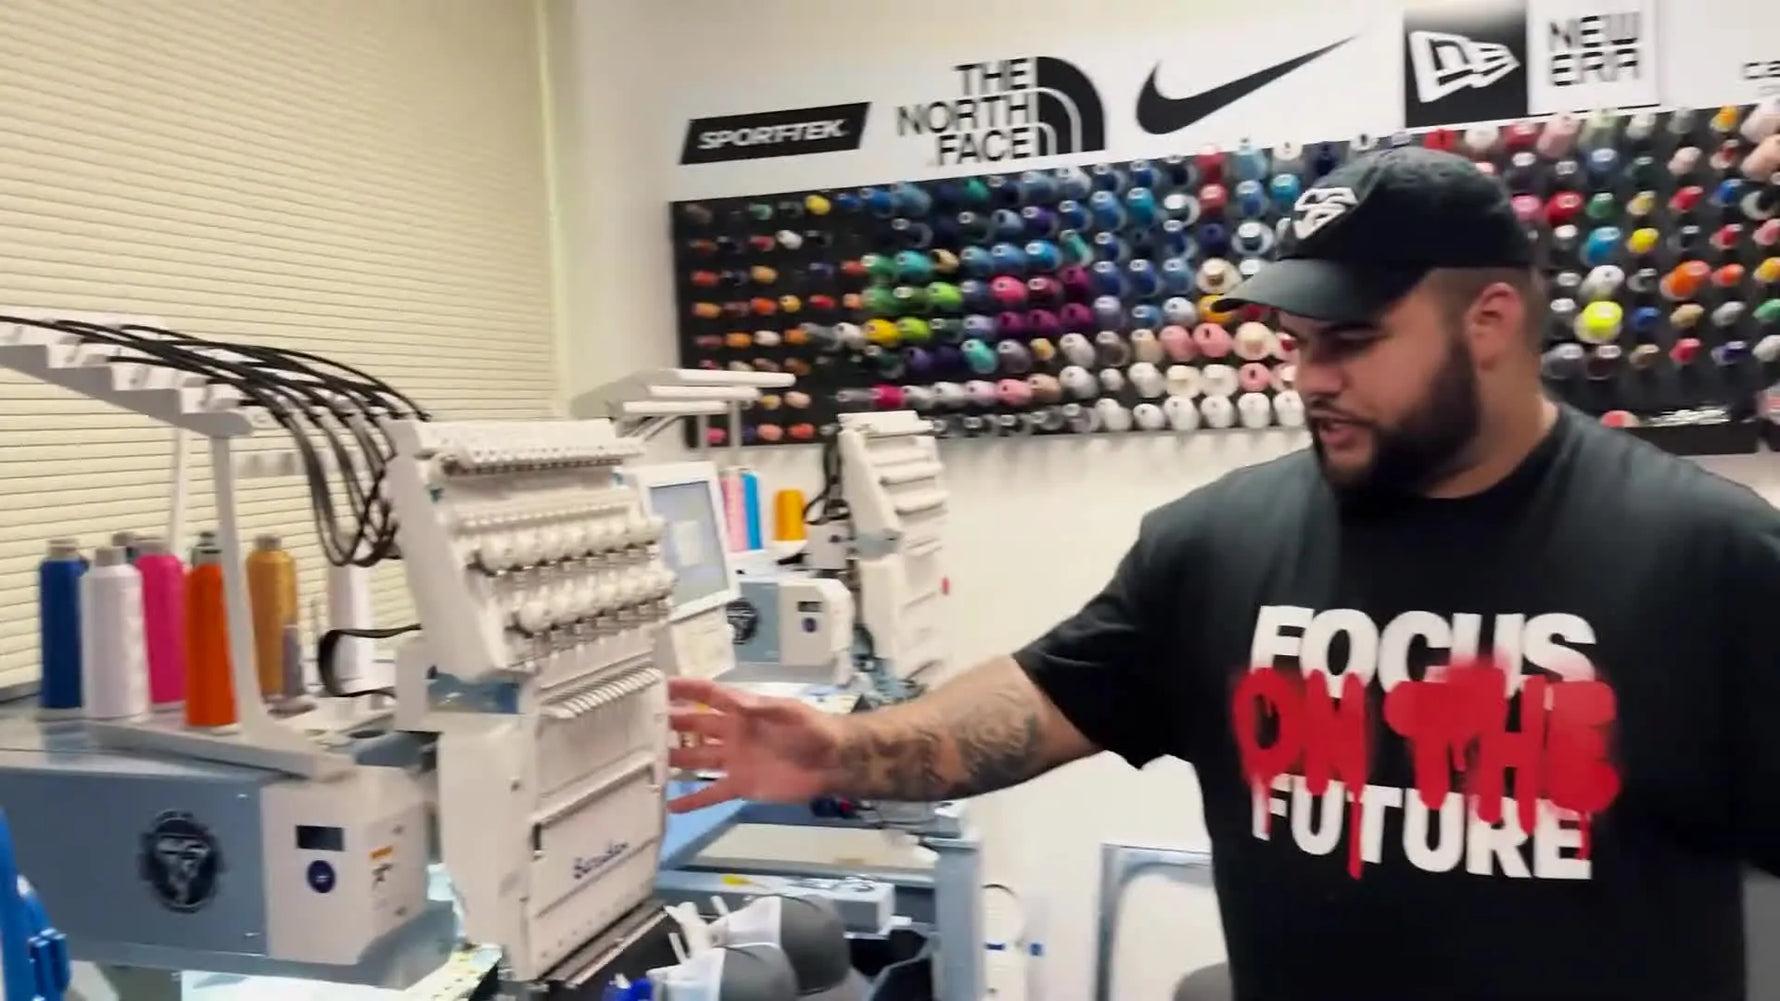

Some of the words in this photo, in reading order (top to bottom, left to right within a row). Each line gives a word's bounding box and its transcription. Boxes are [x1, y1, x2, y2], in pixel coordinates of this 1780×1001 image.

[1549, 13, 1639, 51] NEW
[954, 58, 1028, 96] THE
[1551, 49, 1640, 86] ERA
[897, 93, 1028, 136] NORTH
[936, 127, 1030, 166] FACE
[1250, 605, 1597, 698] FOCUS
[1231, 666, 1369, 798] ON
[1383, 655, 1622, 832] THE
[1252, 773, 1593, 880] FUTURE
